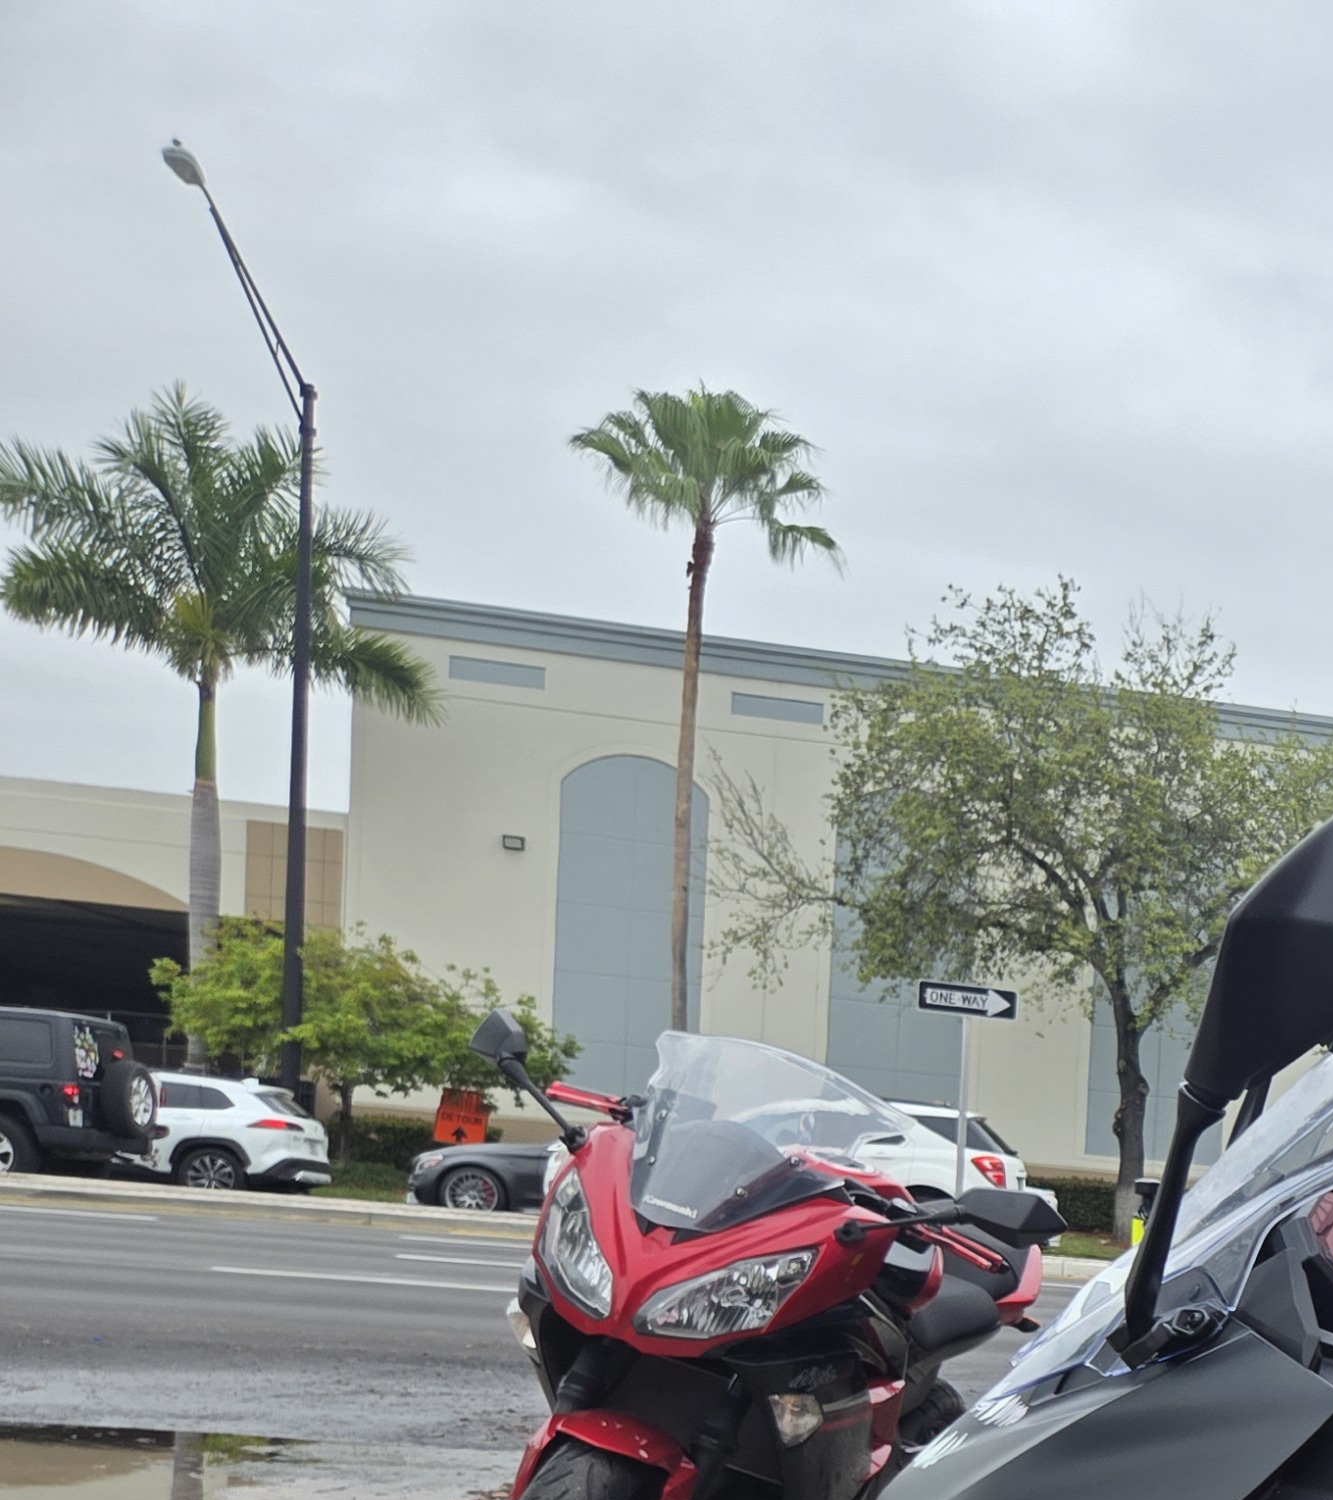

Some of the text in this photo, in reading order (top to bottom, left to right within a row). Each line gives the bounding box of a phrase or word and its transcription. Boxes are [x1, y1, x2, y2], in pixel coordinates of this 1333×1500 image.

[929, 991, 989, 1009] ONE WAY
[441, 1111, 483, 1126] DETOUR
